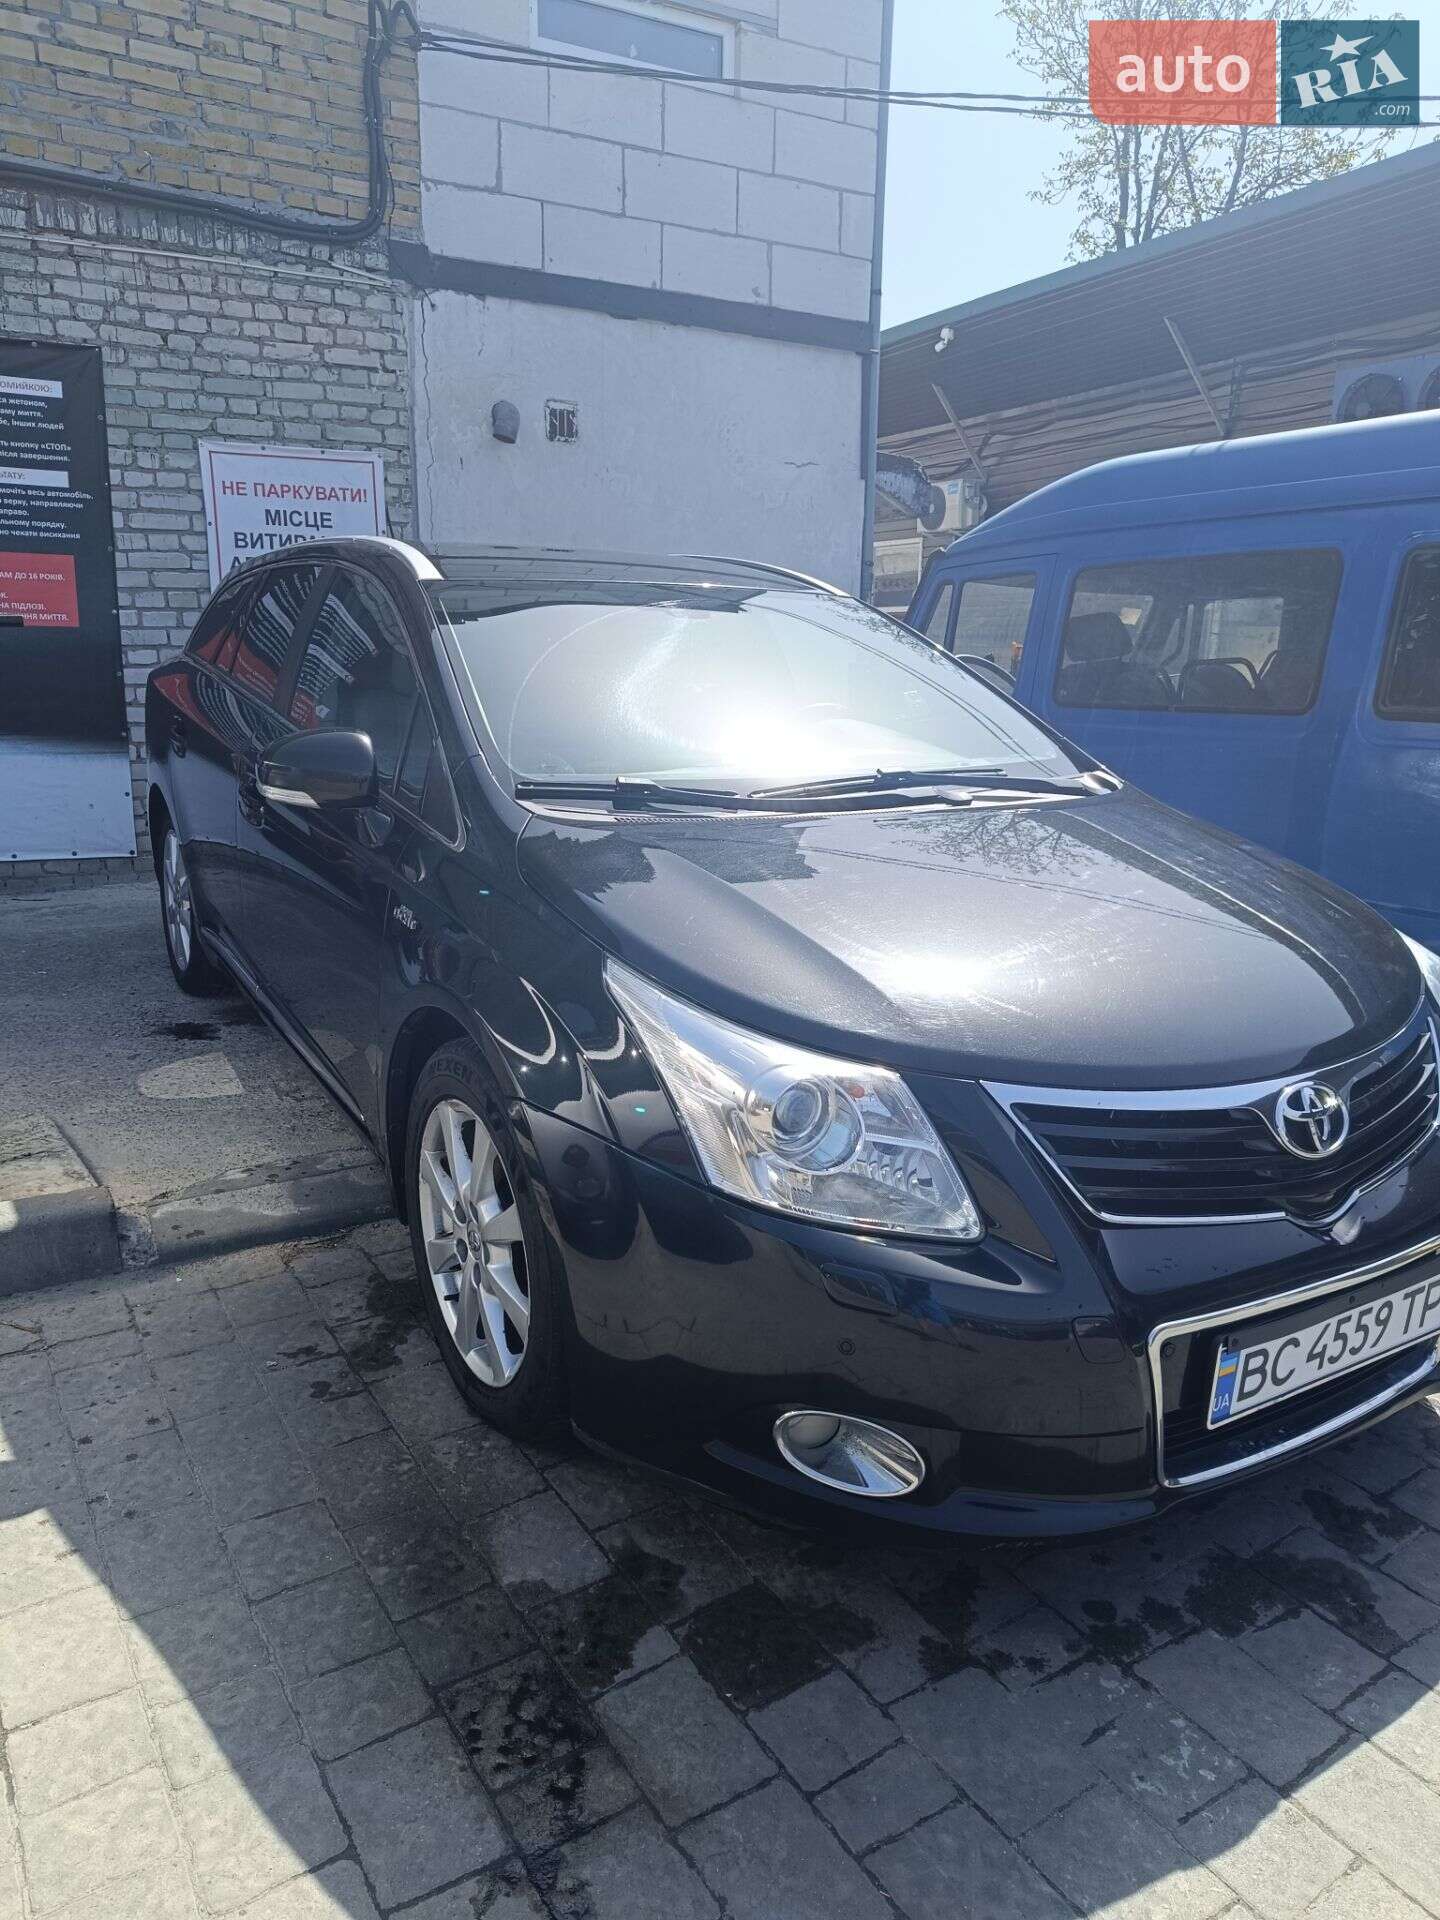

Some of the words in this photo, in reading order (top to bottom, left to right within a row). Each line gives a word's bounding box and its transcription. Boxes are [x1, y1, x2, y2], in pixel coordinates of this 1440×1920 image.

[8, 398, 48, 409] жетоном,
[11, 418, 36, 428] інших
[37, 422, 65, 431] людей
[10, 441, 39, 451] кнопку
[222, 480, 248, 497] НЕ
[253, 482, 368, 503] ПАРКУВАТИ!
[265, 508, 334, 531] МІСЦЕ
[14, 572, 27, 581] ДО
[1237, 1337, 1301, 1403] BC
[1306, 1299, 1394, 1371] 4559
[1212, 1393, 1230, 1412] UA
